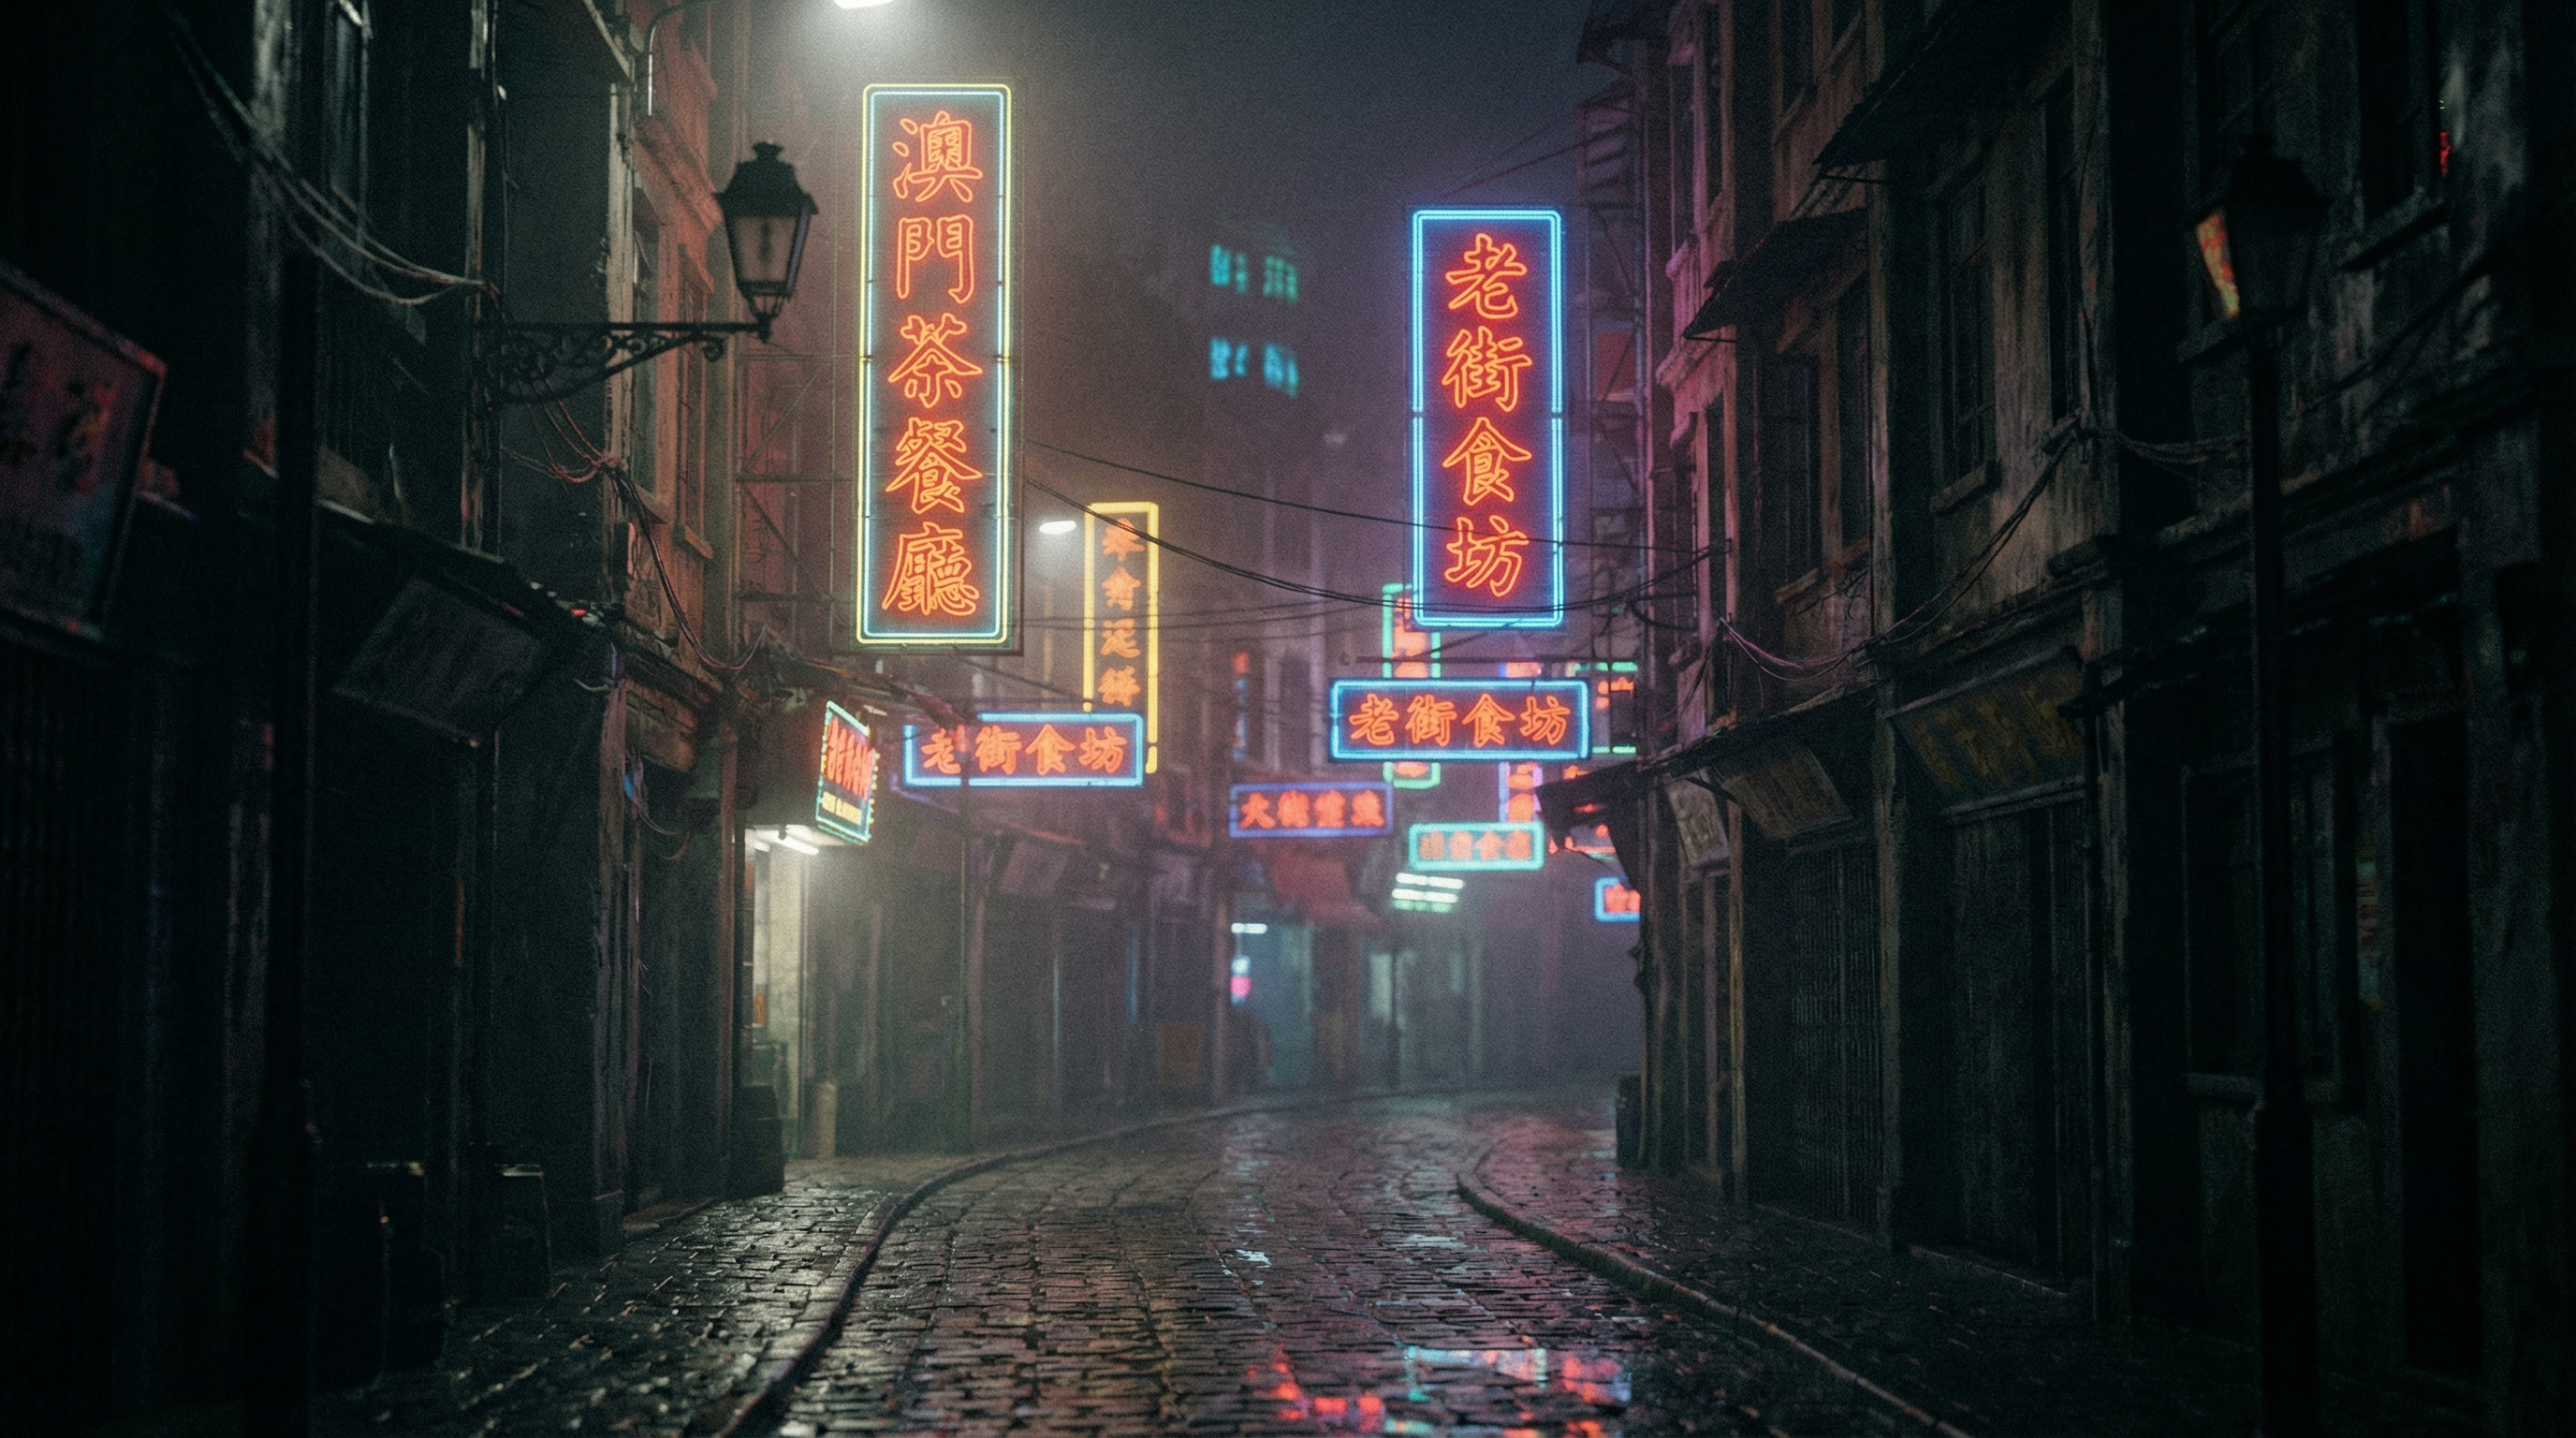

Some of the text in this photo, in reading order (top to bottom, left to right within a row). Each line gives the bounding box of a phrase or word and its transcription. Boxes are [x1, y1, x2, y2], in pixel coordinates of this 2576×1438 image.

[882, 110, 983, 616] 澳門茶餐廳
[1442, 232, 1532, 597] 老街食坊
[921, 724, 1128, 776] 老街食坊
[1349, 693, 1572, 748] 老街食坊
